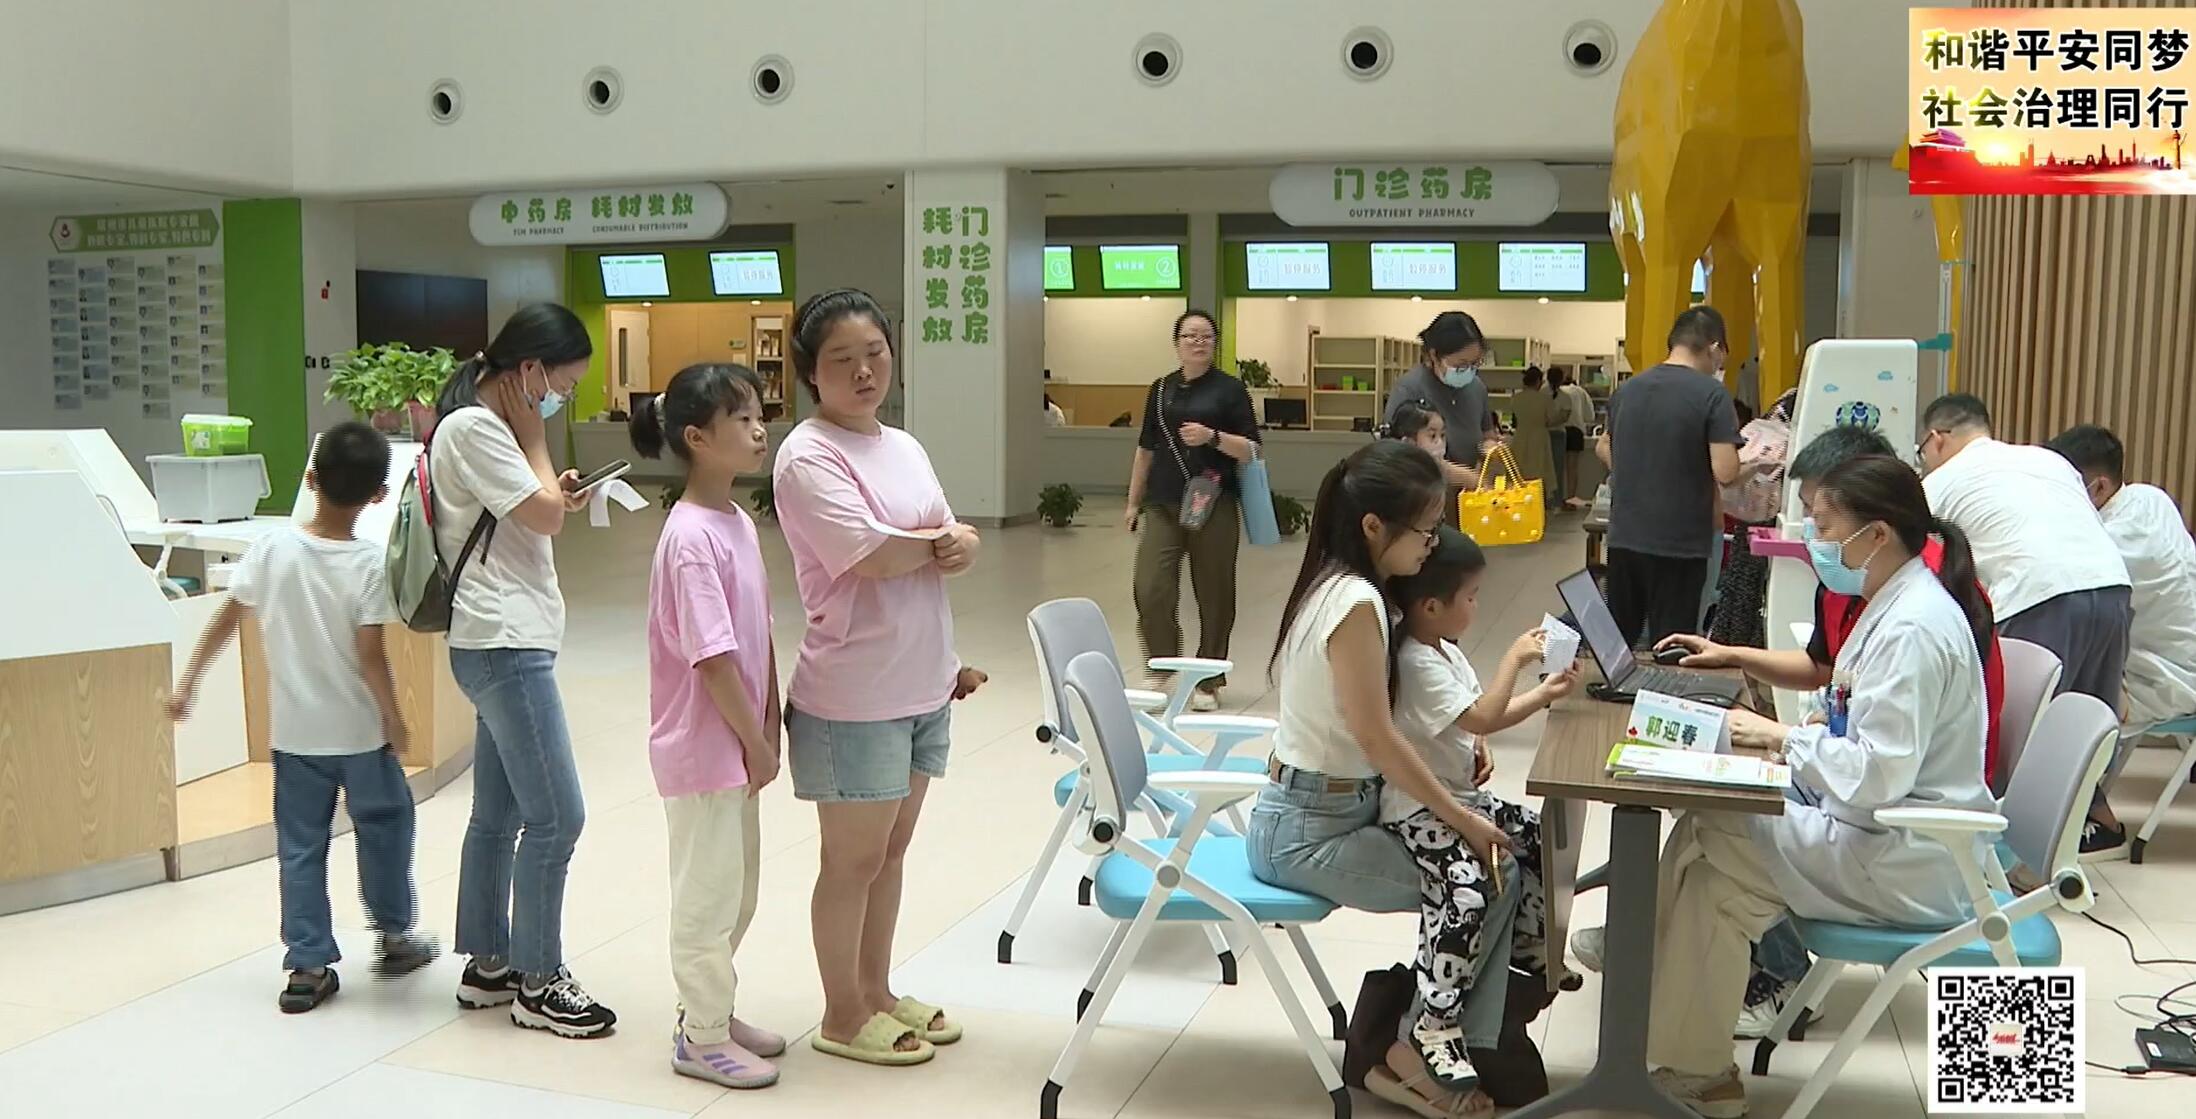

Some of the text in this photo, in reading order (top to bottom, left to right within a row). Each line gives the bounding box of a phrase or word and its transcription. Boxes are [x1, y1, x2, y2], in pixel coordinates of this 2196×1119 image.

[1333, 165, 1493, 201] 门诊药房
[501, 191, 694, 224] 中药房 耗材发放
[1349, 207, 1476, 218] OUTPATIENT PHARMACY
[922, 206, 953, 343] 耗材发放
[958, 205, 991, 344] 门诊药房
